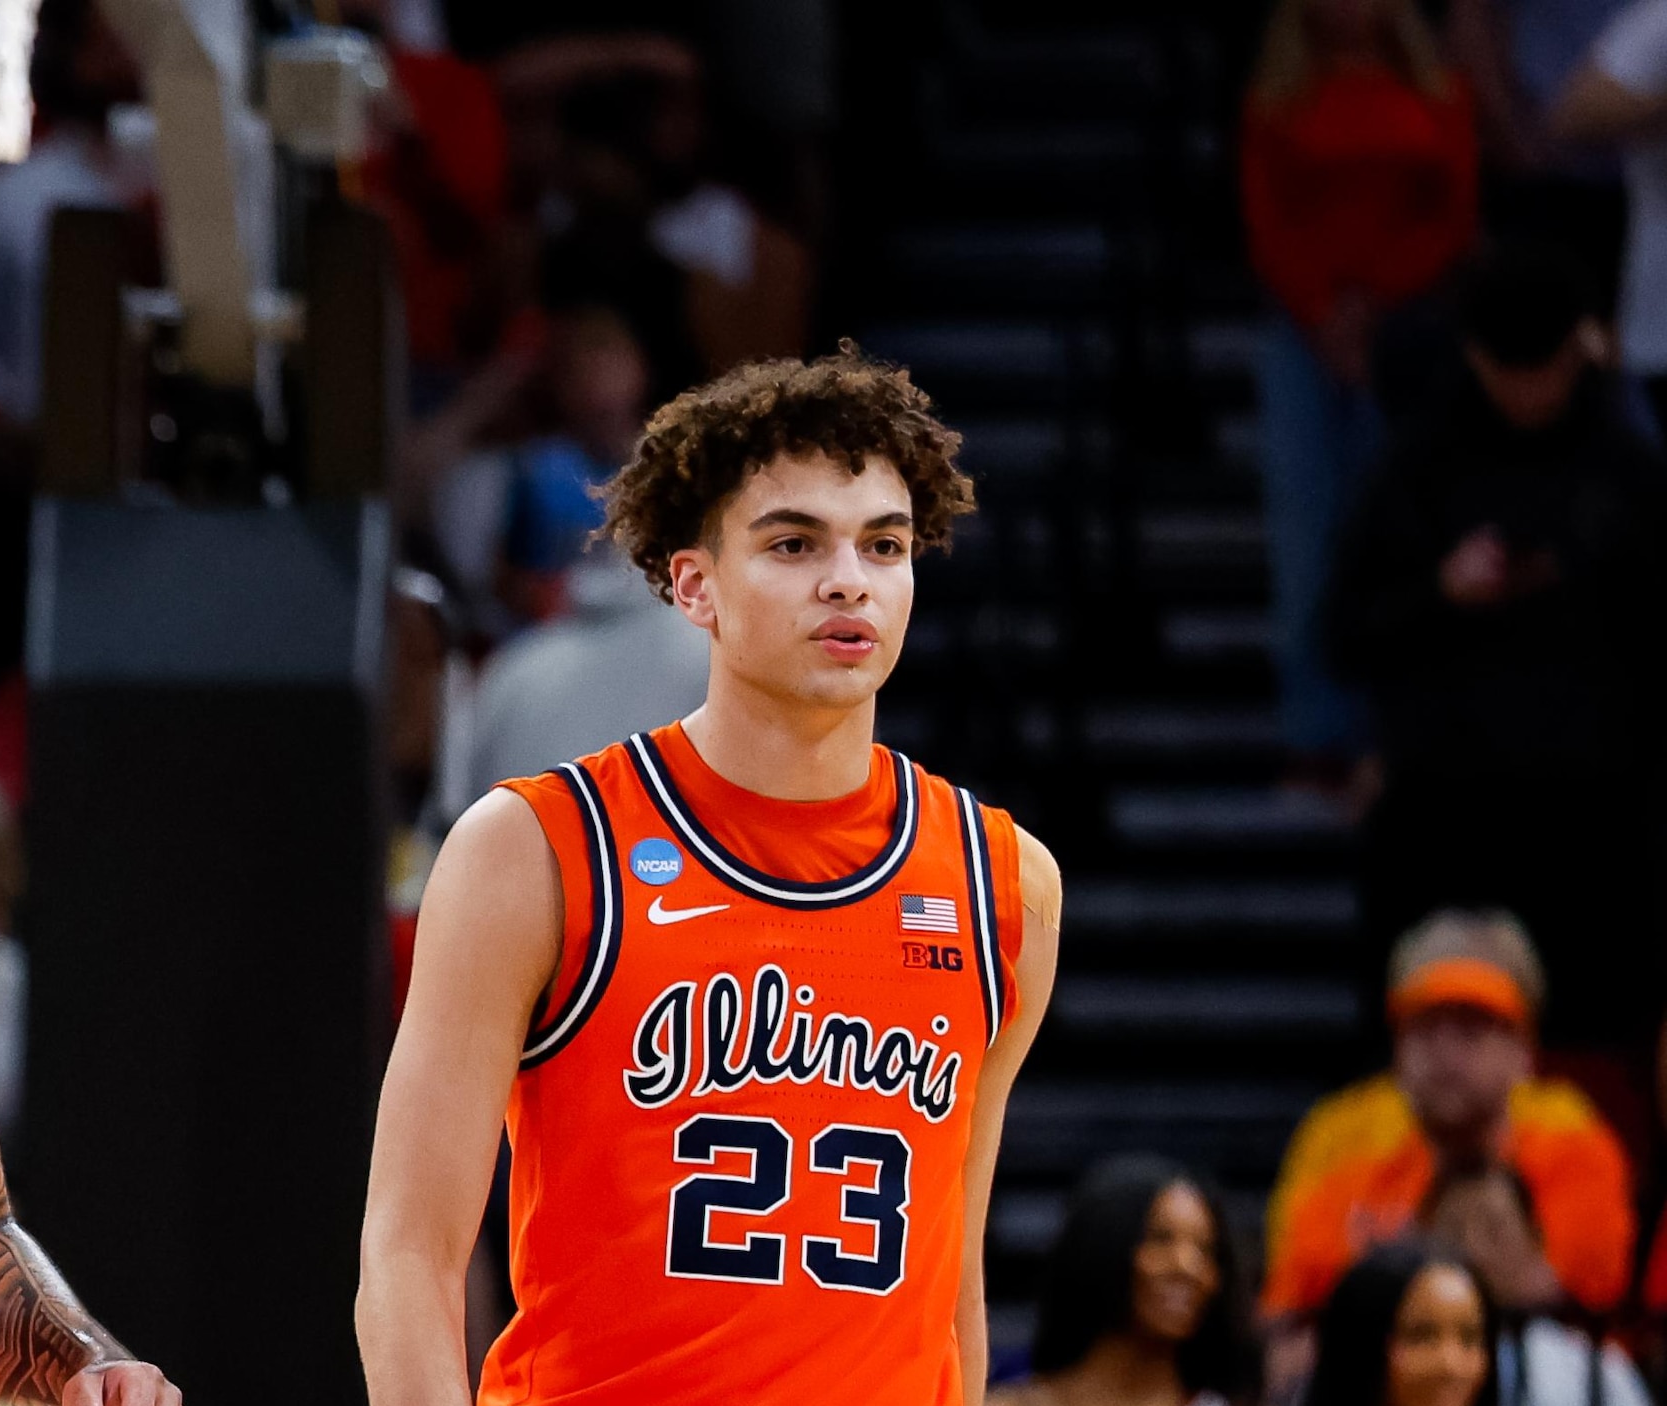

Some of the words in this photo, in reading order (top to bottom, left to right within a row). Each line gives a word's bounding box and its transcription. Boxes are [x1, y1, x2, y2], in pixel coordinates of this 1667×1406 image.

[637, 859, 679, 873] NCAA
[623, 964, 962, 1124] Illinois
[664, 1112, 912, 1297] 23
